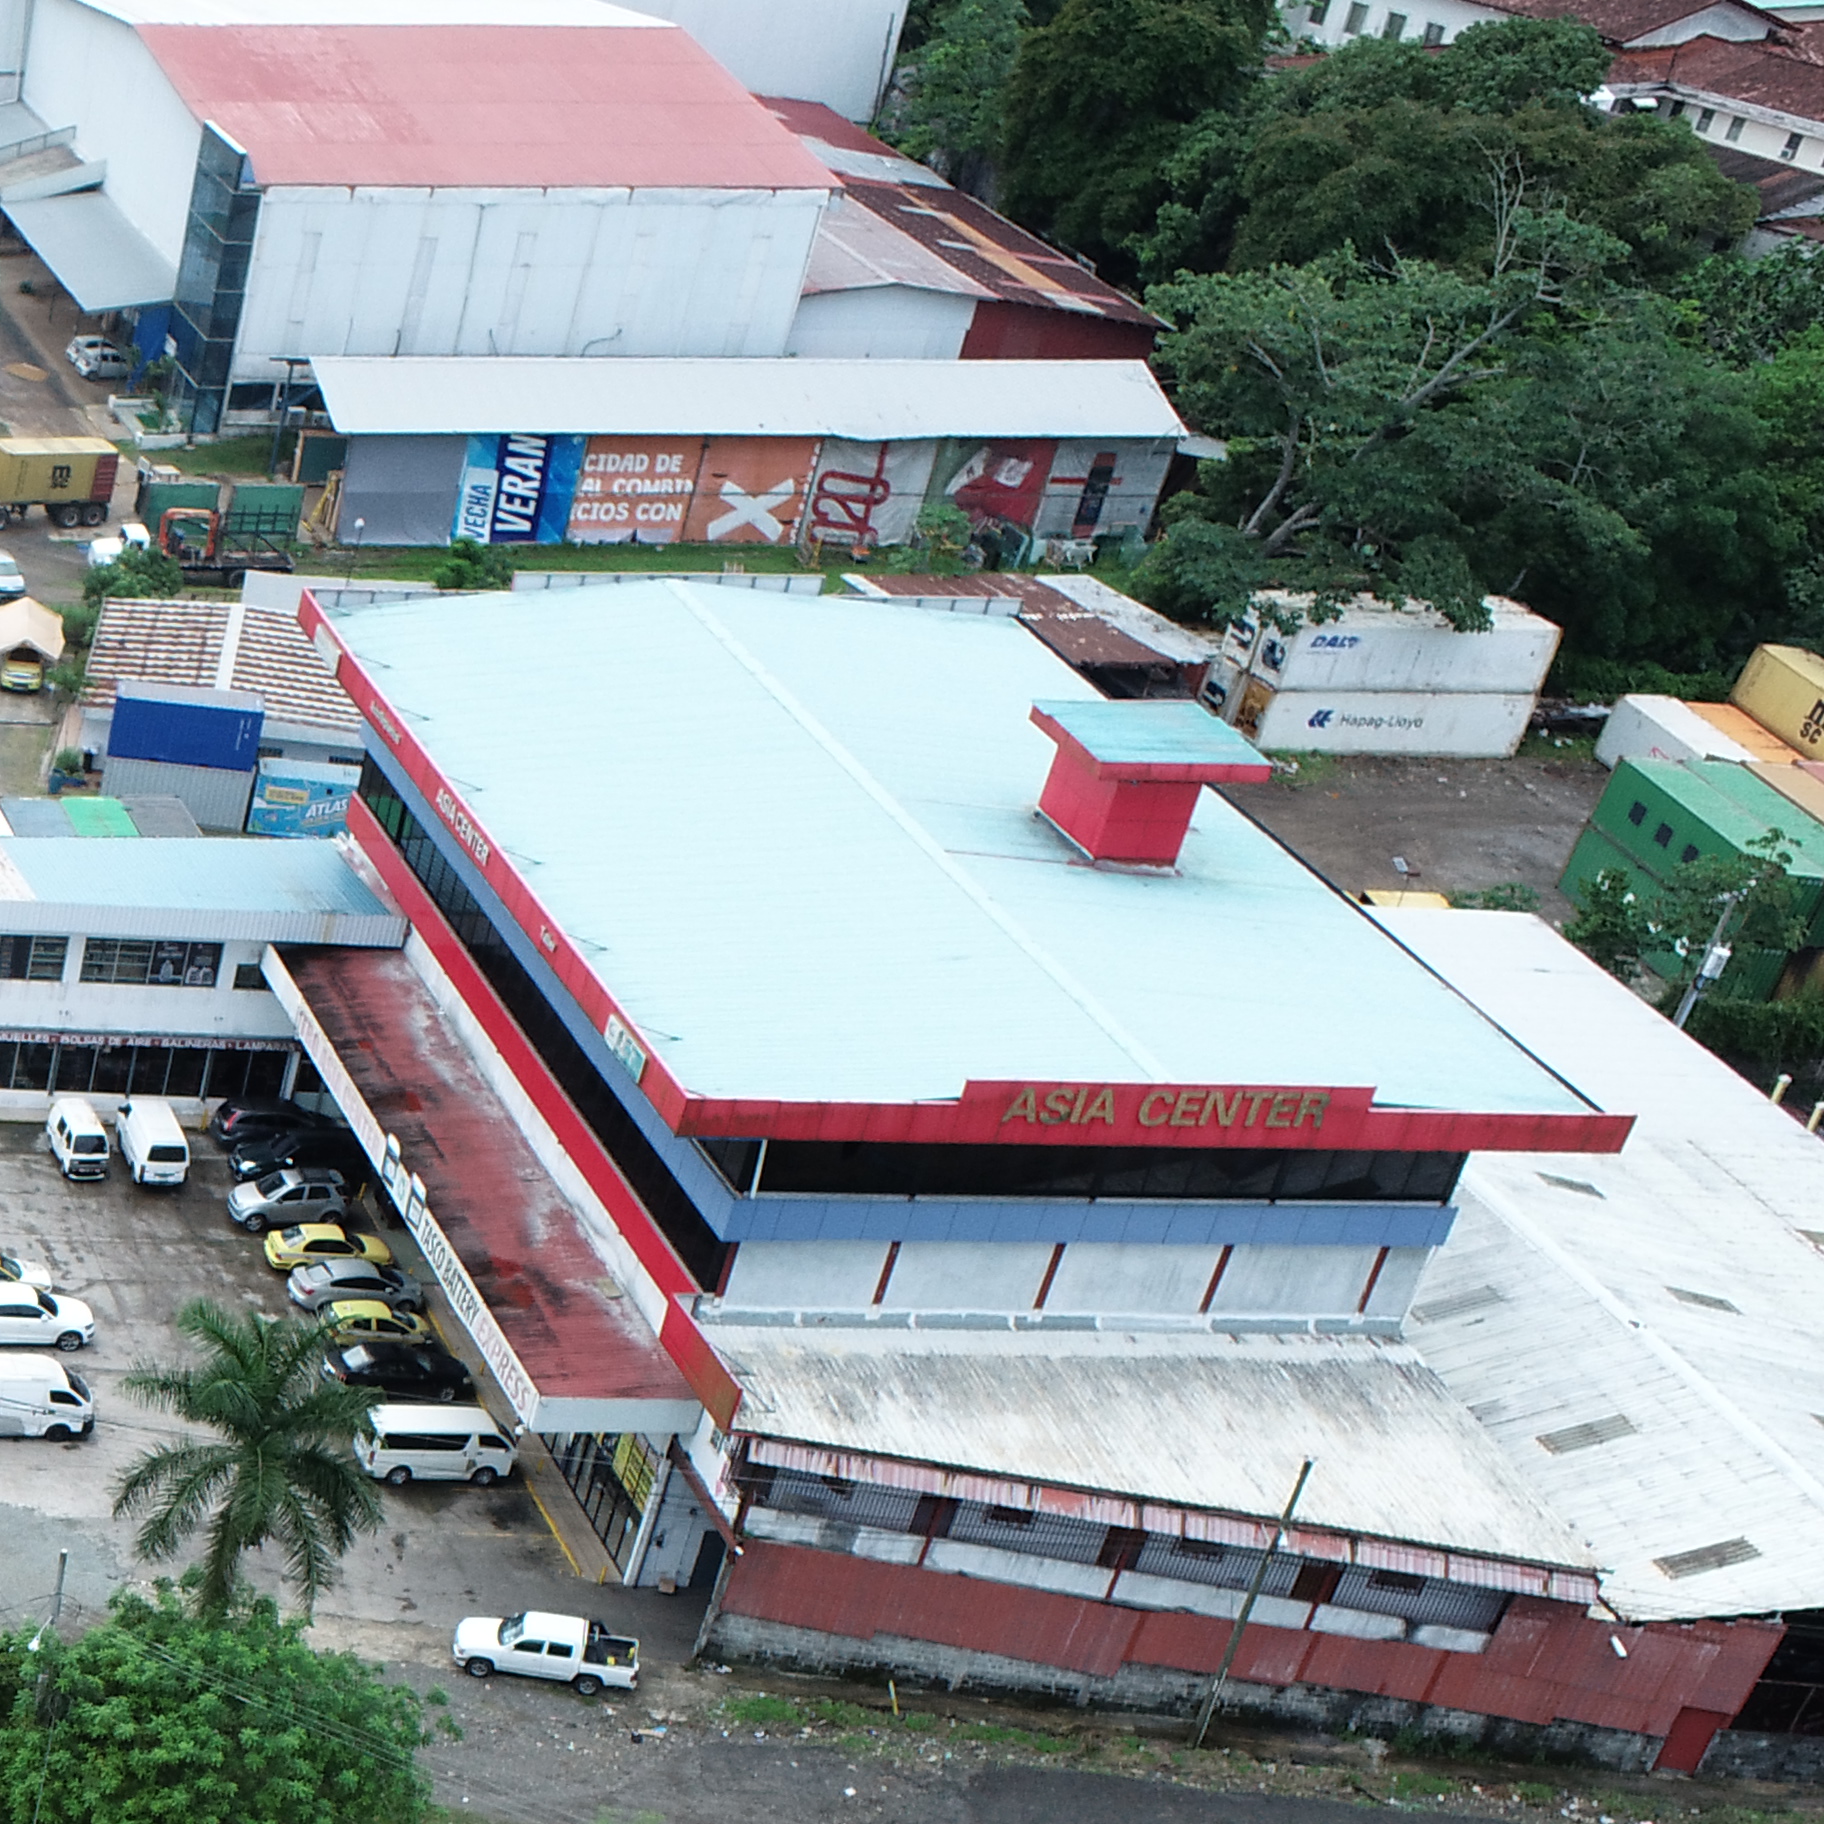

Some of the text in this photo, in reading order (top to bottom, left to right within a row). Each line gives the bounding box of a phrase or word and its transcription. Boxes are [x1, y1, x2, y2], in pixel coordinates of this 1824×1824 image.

[654, 453, 684, 474] DE
[636, 502, 683, 522] CON
[454, 811, 490, 868] CENTER
[1001, 1086, 1332, 1129] ASIA CENTER
[421, 1218, 531, 1411] TASCO BATTERY EXPRESS
